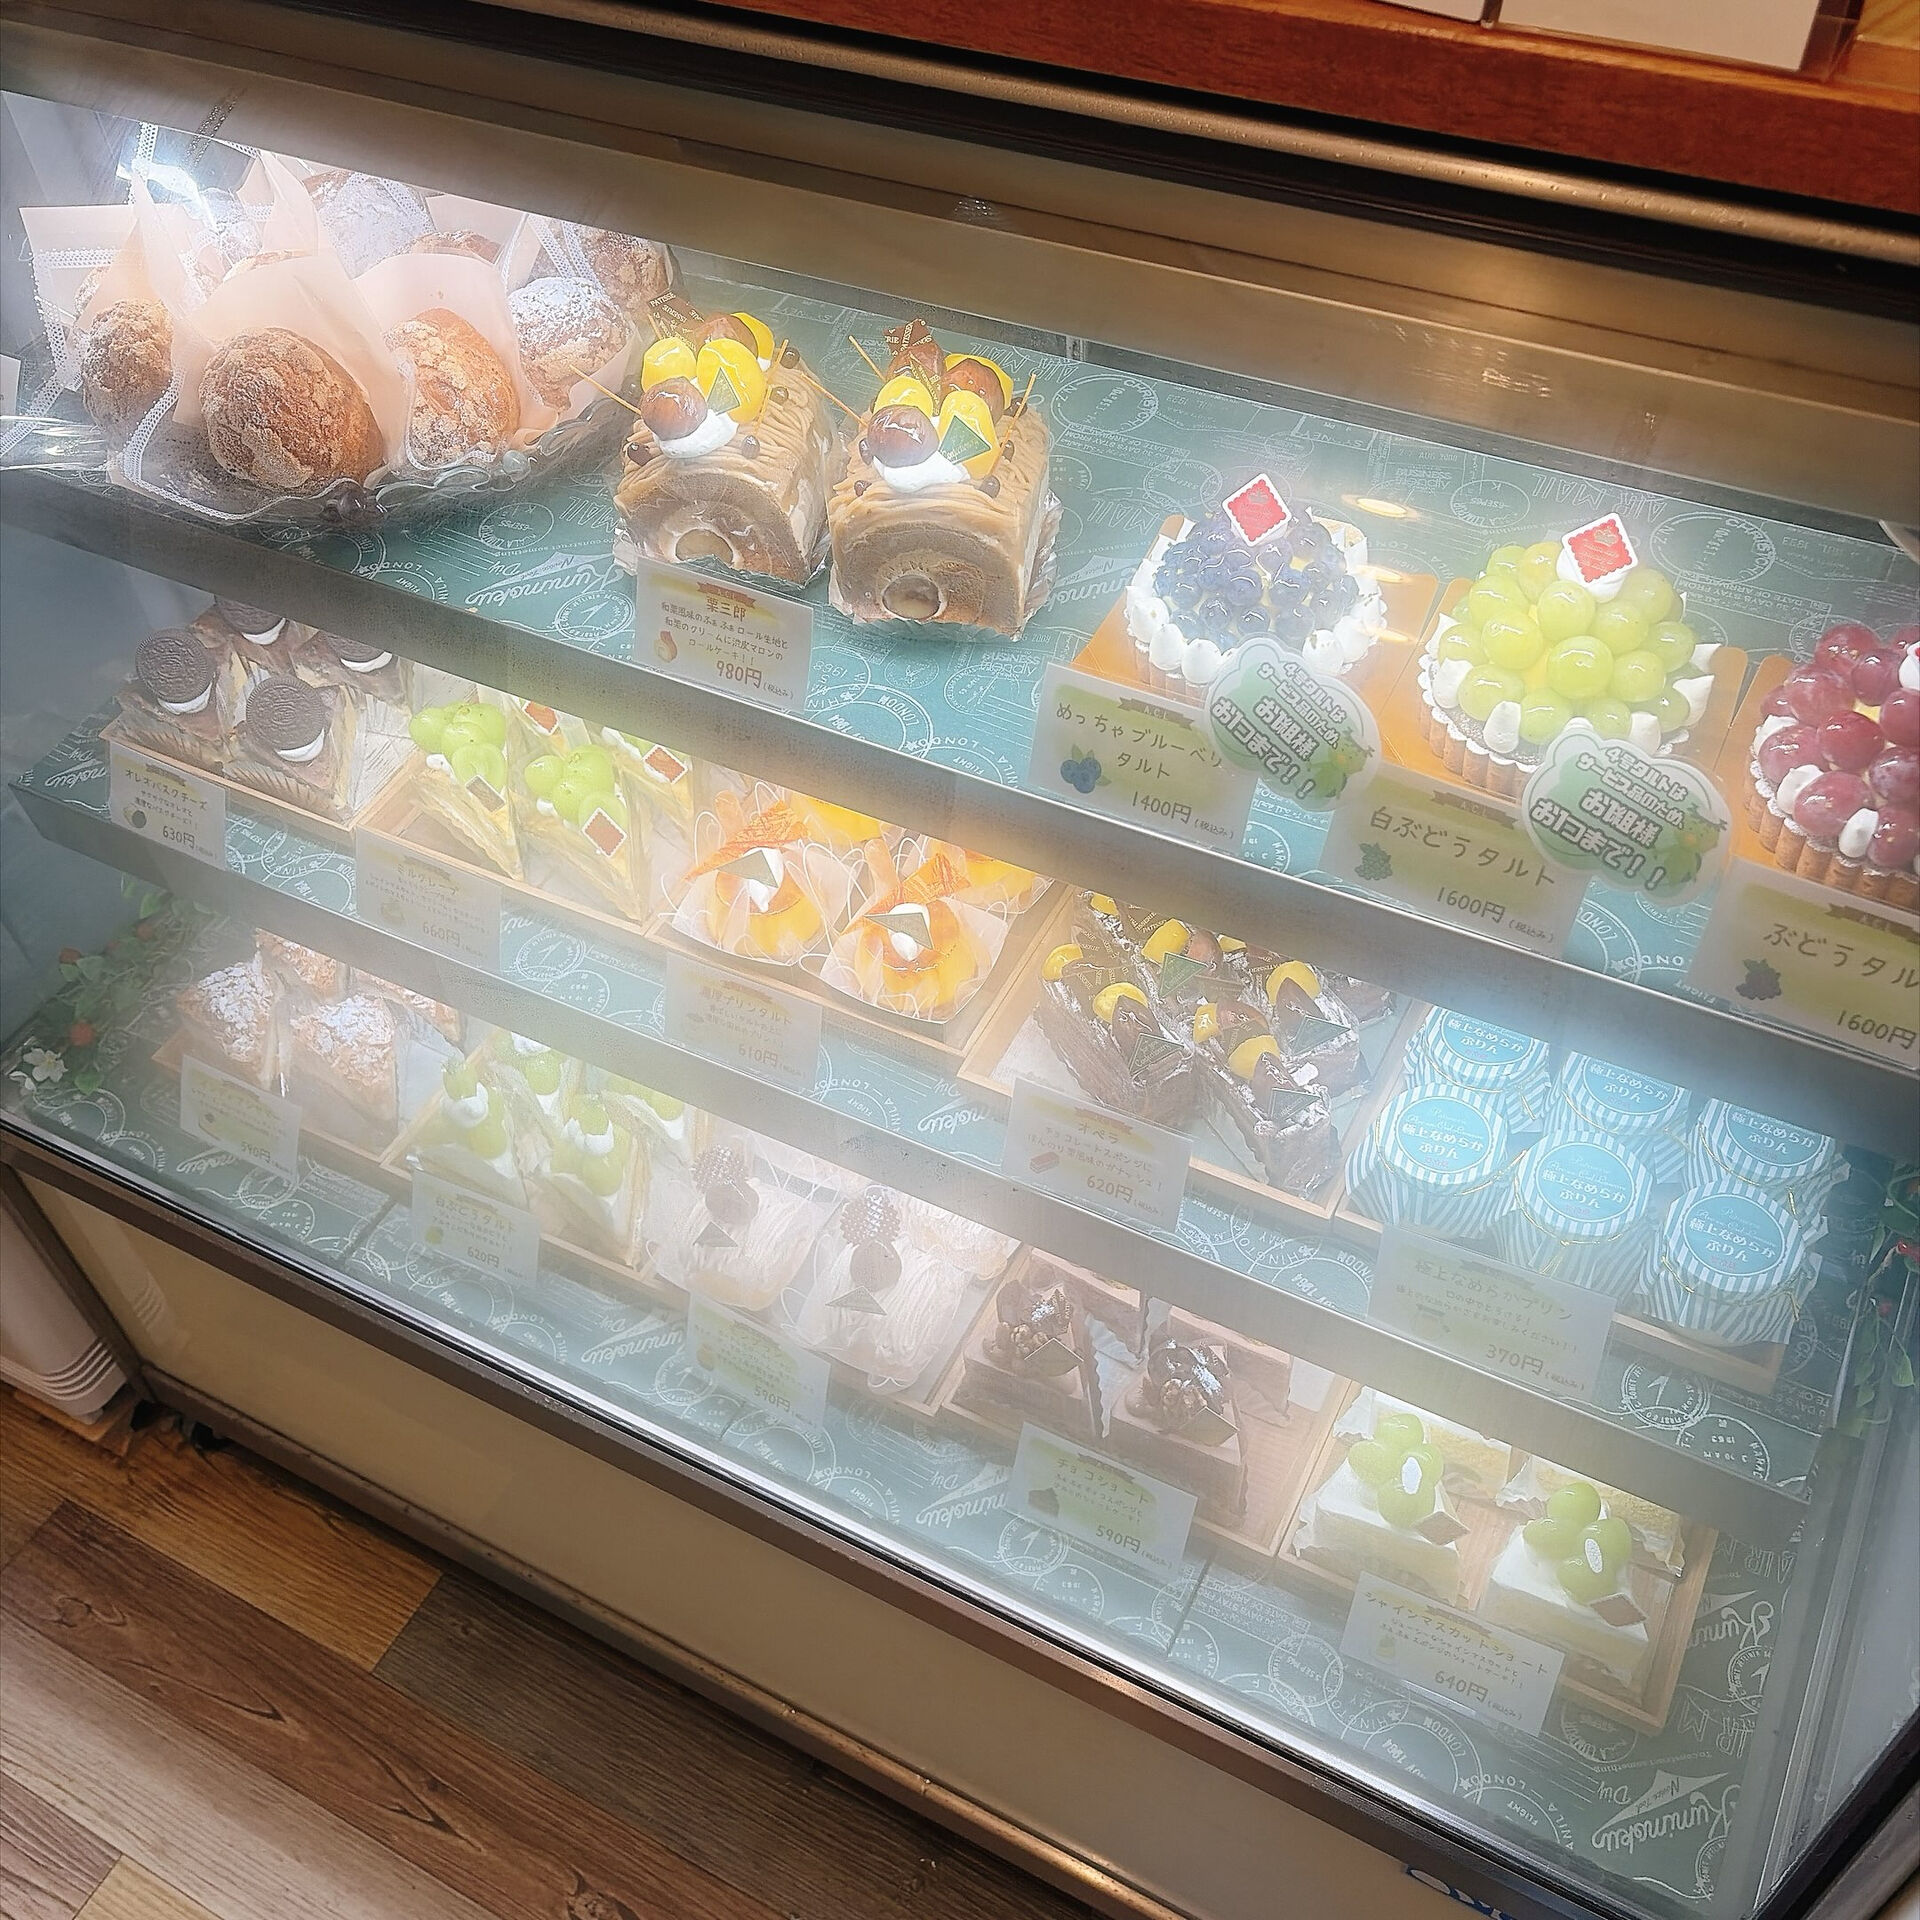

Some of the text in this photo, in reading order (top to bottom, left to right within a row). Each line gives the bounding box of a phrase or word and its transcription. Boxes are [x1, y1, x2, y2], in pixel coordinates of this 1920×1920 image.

[706, 596, 747, 622] 栗三郎
[716, 660, 762, 689] 980円
[1117, 751, 1171, 779] タルト
[1605, 746, 1688, 802] 4号タルトは
[1131, 791, 1192, 824] 1400円
[1576, 752, 1685, 830] サービス品のため、
[163, 825, 195, 850] 630円
[1369, 806, 1555, 888] 白ぶどうタルト
[1437, 887, 1506, 923] 1600円
[422, 922, 461, 948] 660円
[1448, 1019, 1524, 1053] 極上なめらか
[1837, 1010, 1916, 1050] 1600円
[738, 1043, 778, 1068] 610円
[1589, 1062, 1668, 1101] 極上なめらか
[1078, 1123, 1120, 1145] オペラ
[1402, 1123, 1484, 1152] 極上なめらか
[1730, 1111, 1815, 1149] 極上なめらか
[1086, 1175, 1134, 1203] 620円
[1542, 1169, 1627, 1204] 極上なめらか
[1690, 1218, 1776, 1259] 極上なめらか
[467, 1246, 500, 1268] 620円
[1485, 1343, 1544, 1376] 370円
[754, 1385, 791, 1412] 590円
[1057, 1457, 1149, 1505] チョコショート
[1095, 1525, 1142, 1554] 590円
[1365, 1591, 1548, 1675] シャインマスカットショート
[1434, 1670, 1489, 1702] 640円
